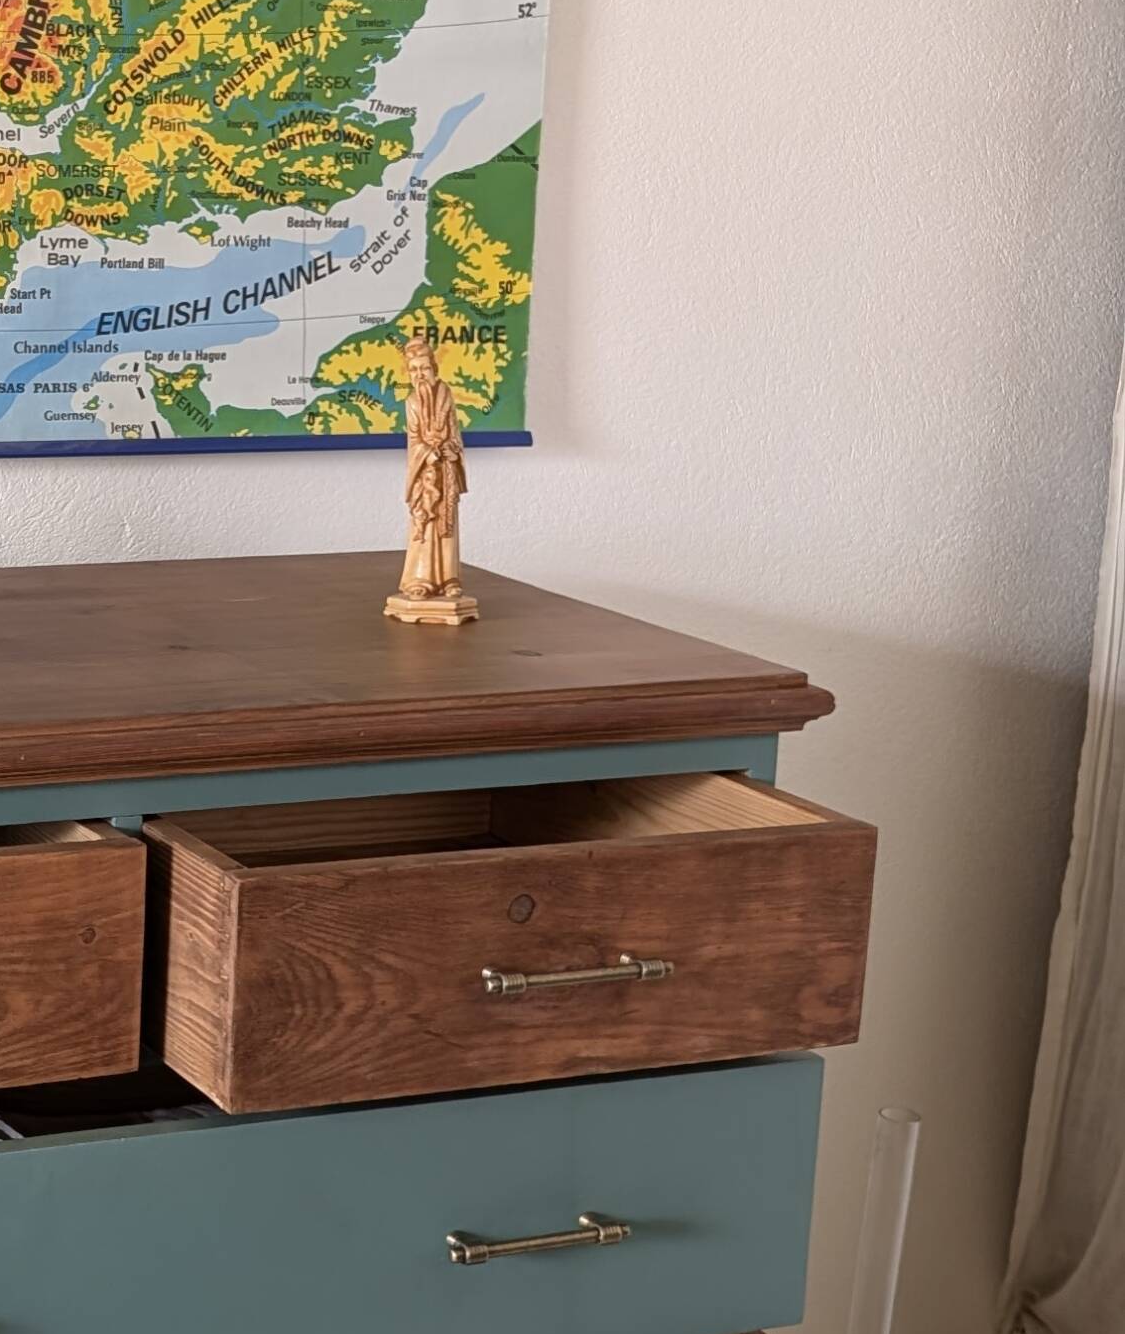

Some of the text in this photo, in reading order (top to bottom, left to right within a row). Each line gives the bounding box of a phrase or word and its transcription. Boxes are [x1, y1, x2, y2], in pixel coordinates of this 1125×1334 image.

[103, 28, 186, 116] COTSWOLD
[277, 173, 336, 187] SUSSEX
[287, 217, 349, 230] Beachy Head
[96, 250, 342, 336] ENGLISH CHANNEL
[412, 325, 506, 344] FRANCE
[13, 341, 119, 355] Channel Islands
[91, 371, 141, 386] Alderney
[33, 382, 77, 393] PARIS
